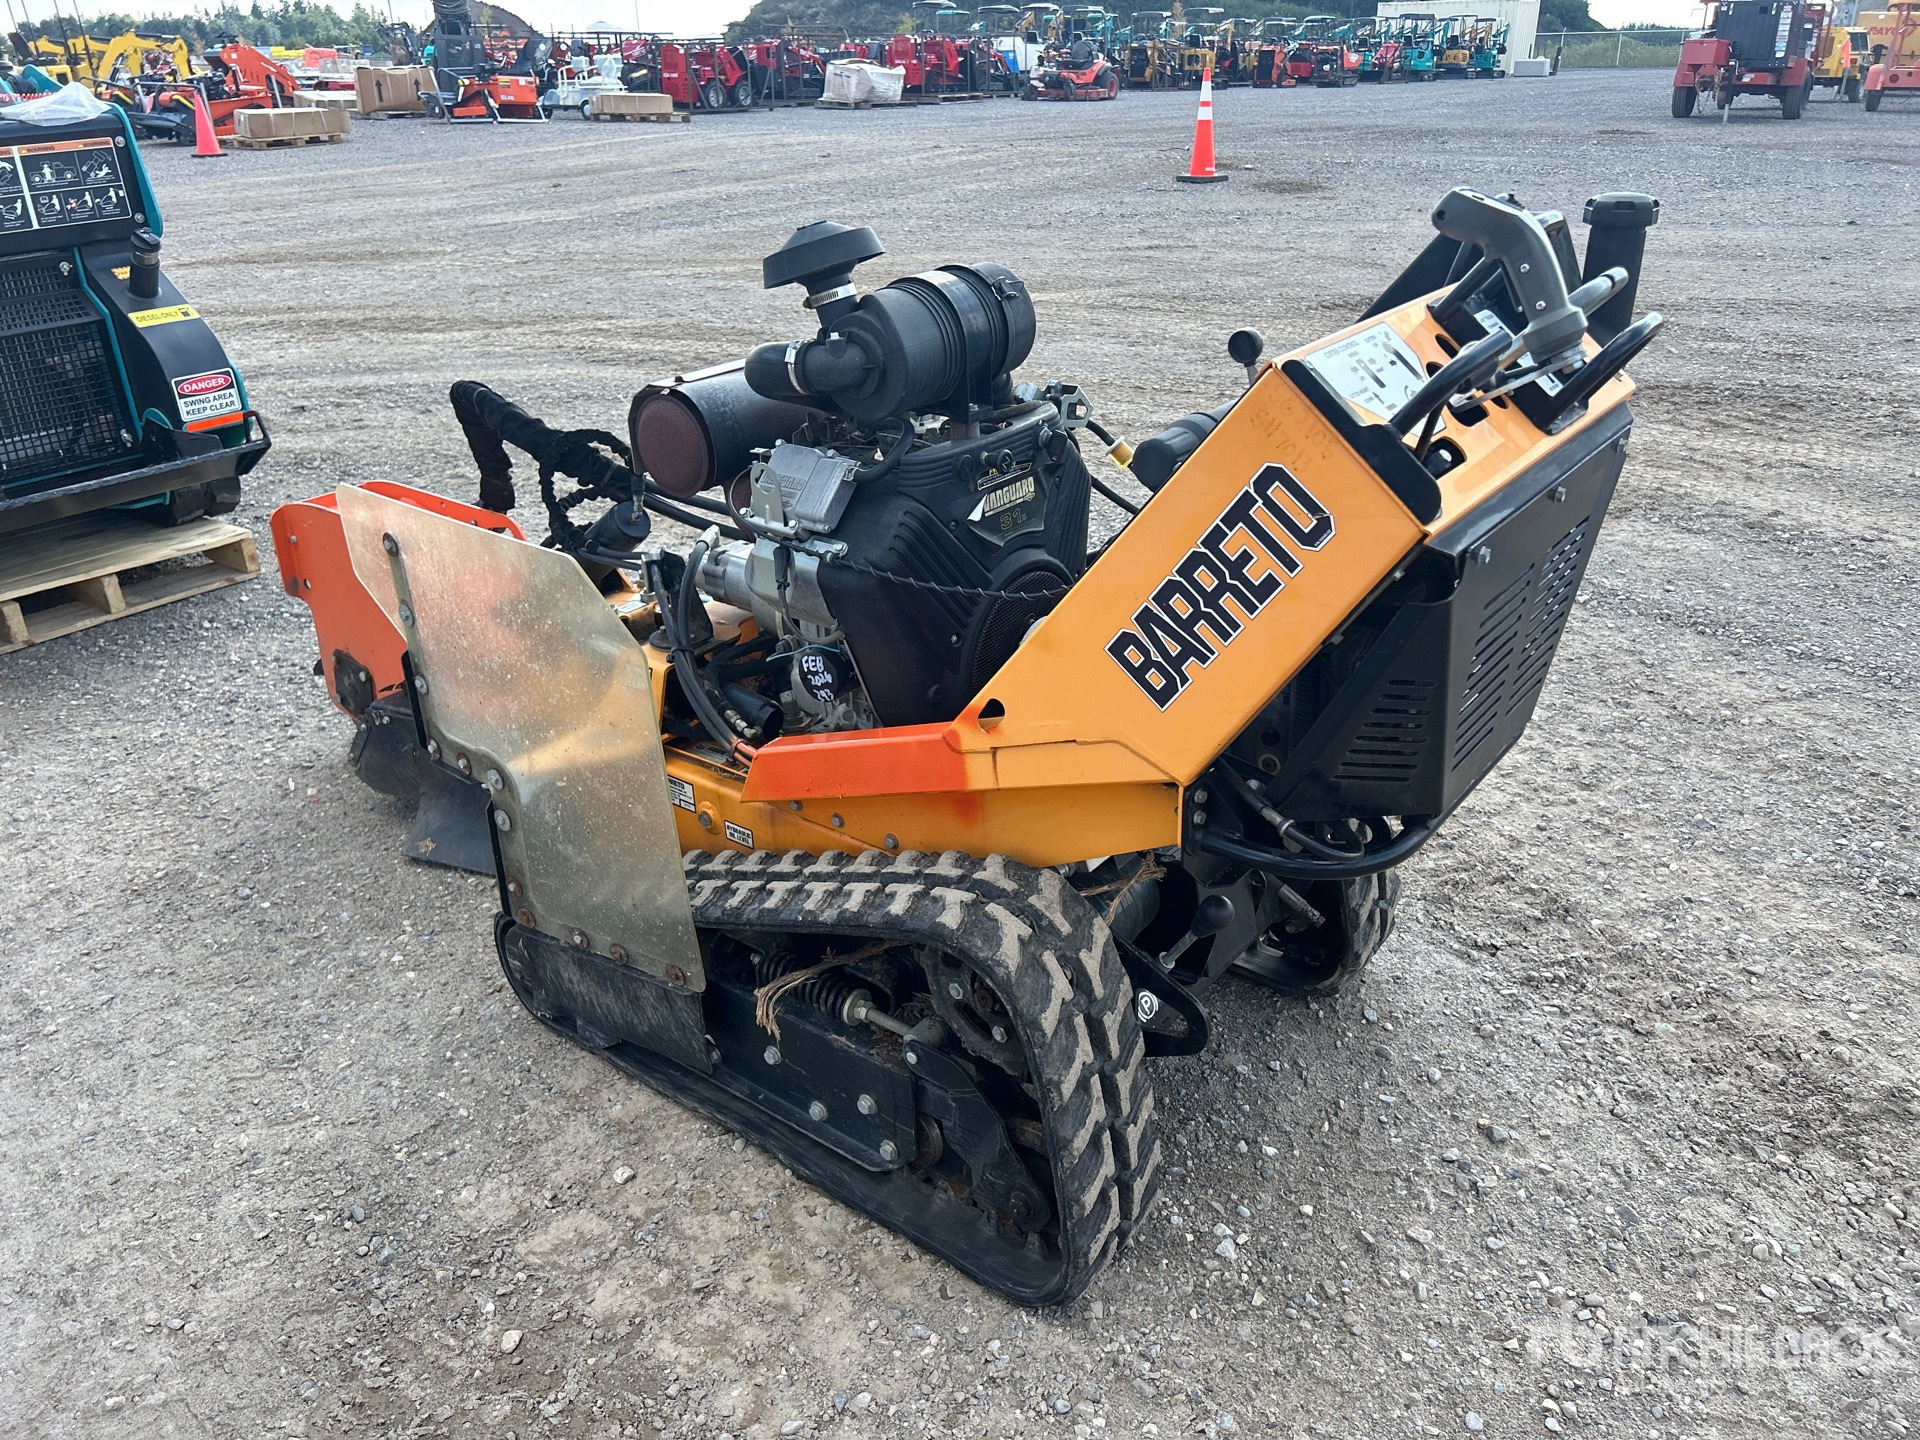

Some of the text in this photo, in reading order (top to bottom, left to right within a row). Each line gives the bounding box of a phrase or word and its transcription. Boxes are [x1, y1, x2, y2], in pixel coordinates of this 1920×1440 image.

[26, 145, 56, 153] WARNING
[82, 140, 111, 148] WARNING
[135, 310, 180, 323] DIESEL ONLY
[183, 377, 226, 393] DANGER
[183, 391, 234, 408] SWING AREA
[185, 400, 236, 417] KEEP CLEAR
[983, 476, 1035, 512] VANGUARD
[1104, 462, 1336, 713] BARRETO
[801, 655, 824, 672] FEB
